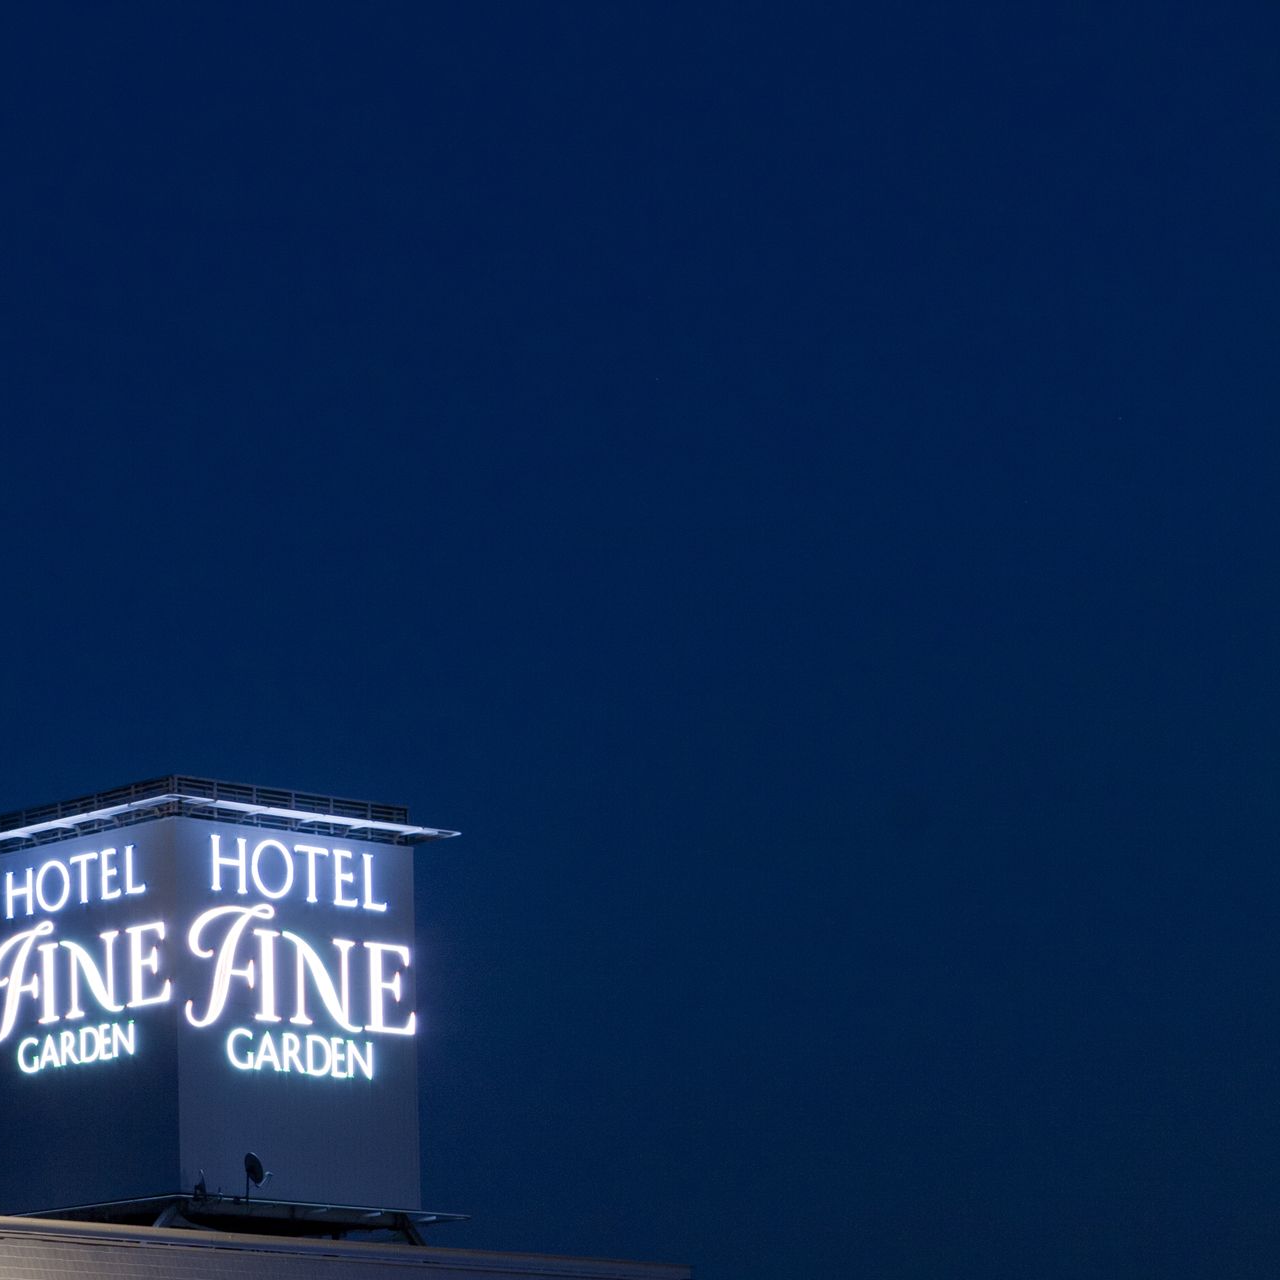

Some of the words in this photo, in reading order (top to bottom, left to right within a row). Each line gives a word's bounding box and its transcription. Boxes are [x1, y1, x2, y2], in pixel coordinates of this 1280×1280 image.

[5, 845, 146, 919] HOTEL
[211, 834, 387, 912] HOTEL
[185, 904, 417, 1036] FINE
[18, 1020, 135, 1074] GARDEN
[227, 1028, 374, 1080] GARDEN
